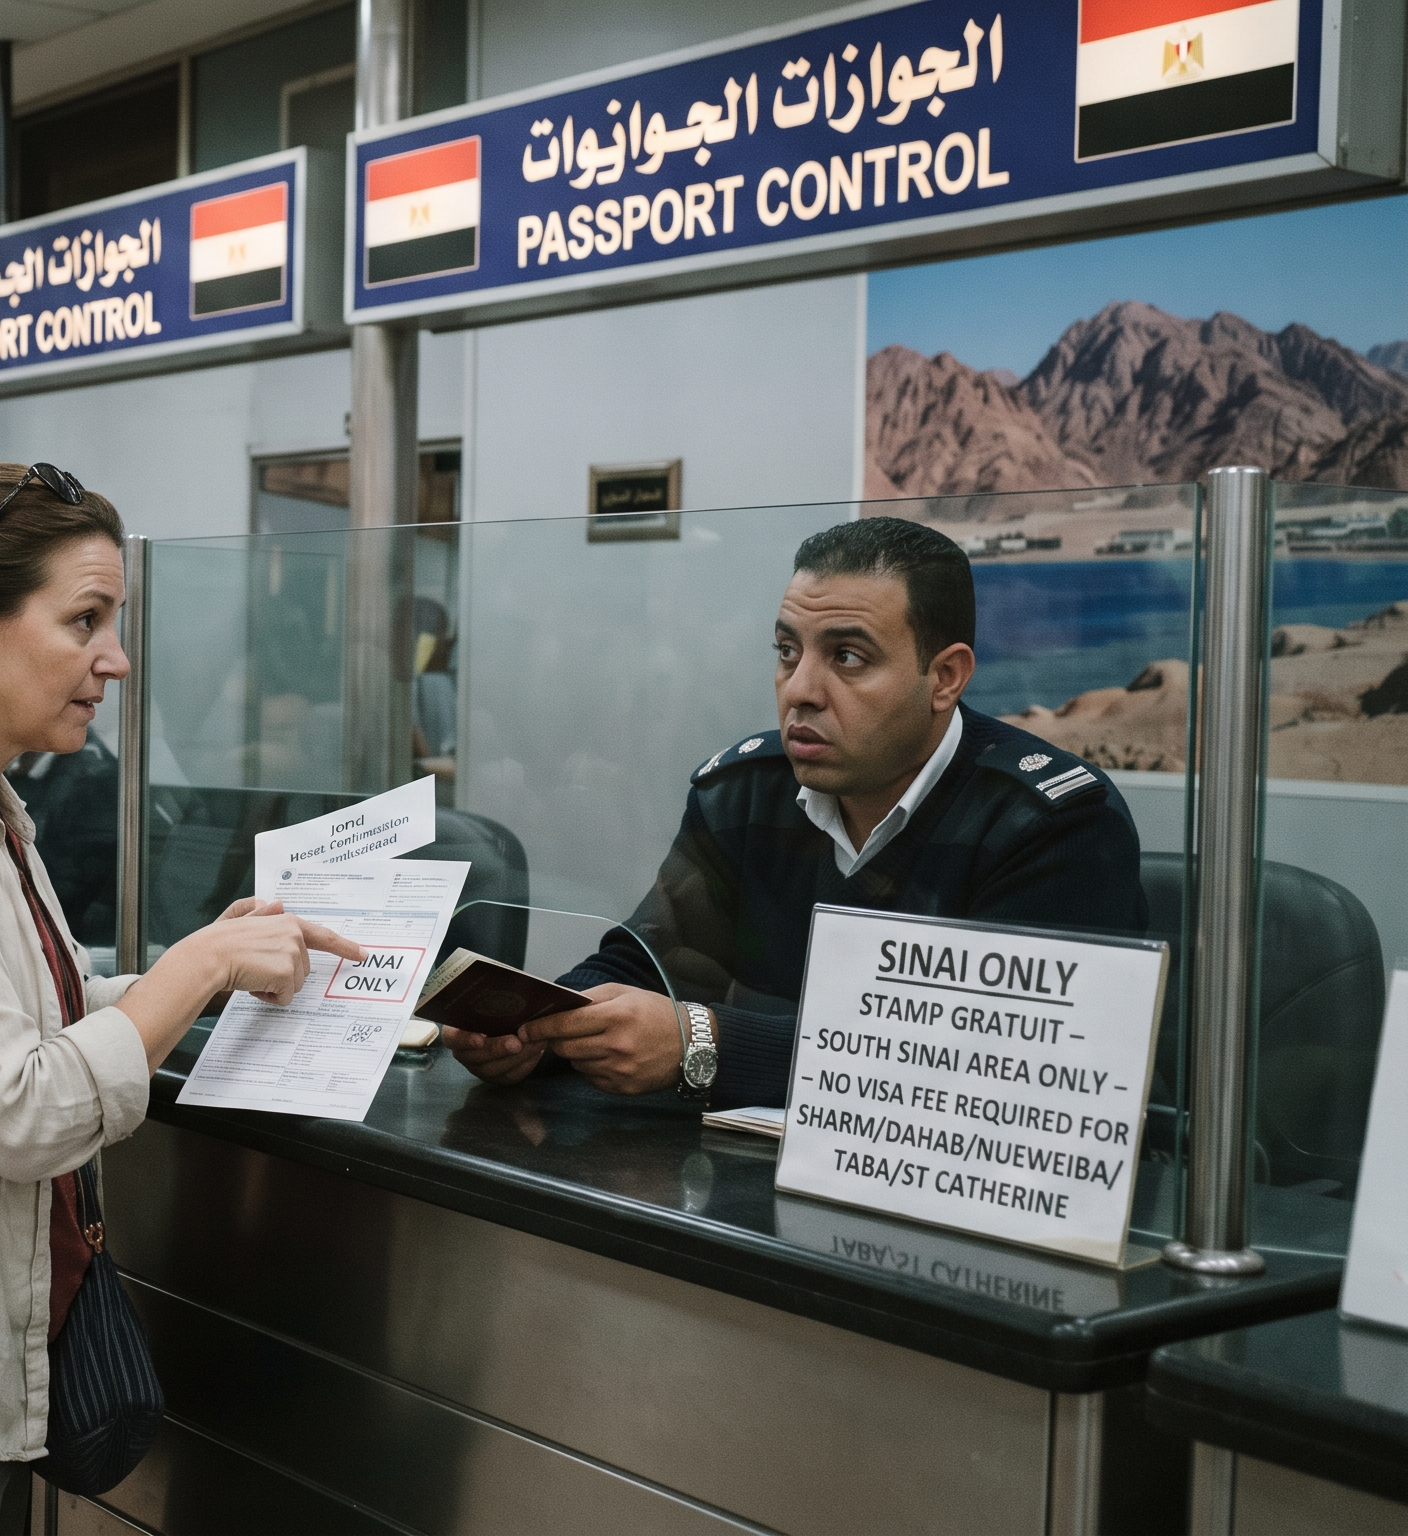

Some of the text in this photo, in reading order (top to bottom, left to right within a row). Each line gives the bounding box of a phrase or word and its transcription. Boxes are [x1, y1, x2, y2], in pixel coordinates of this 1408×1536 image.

[772, 12, 1003, 134] الجوازات
[517, 127, 1010, 269] PASSPORT CONTROL
[47, 216, 162, 292] الجوازات
[35, 290, 162, 354] CONTROL
[344, 975, 398, 992] ONLY
[877, 939, 1078, 997] SINAI ONLY
[859, 992, 944, 1026] STAMP
[951, 1006, 1065, 1045] GRATUIT
[816, 1028, 892, 1061] SOUTH
[897, 1040, 960, 1072] SINAI
[966, 1052, 1031, 1084] AREA
[1038, 1063, 1108, 1096] ONLY
[819, 1069, 851, 1094] NO
[857, 1076, 904, 1105] VISA
[911, 1086, 948, 1113] FEE
[954, 1094, 1073, 1135] REQUIRED
[1080, 1116, 1129, 1146] FOR
[796, 1103, 1124, 1190] SHARM/DAHAB/NUEWEIBA/
[834, 1149, 1070, 1219] TABA/ST CATHERINE
